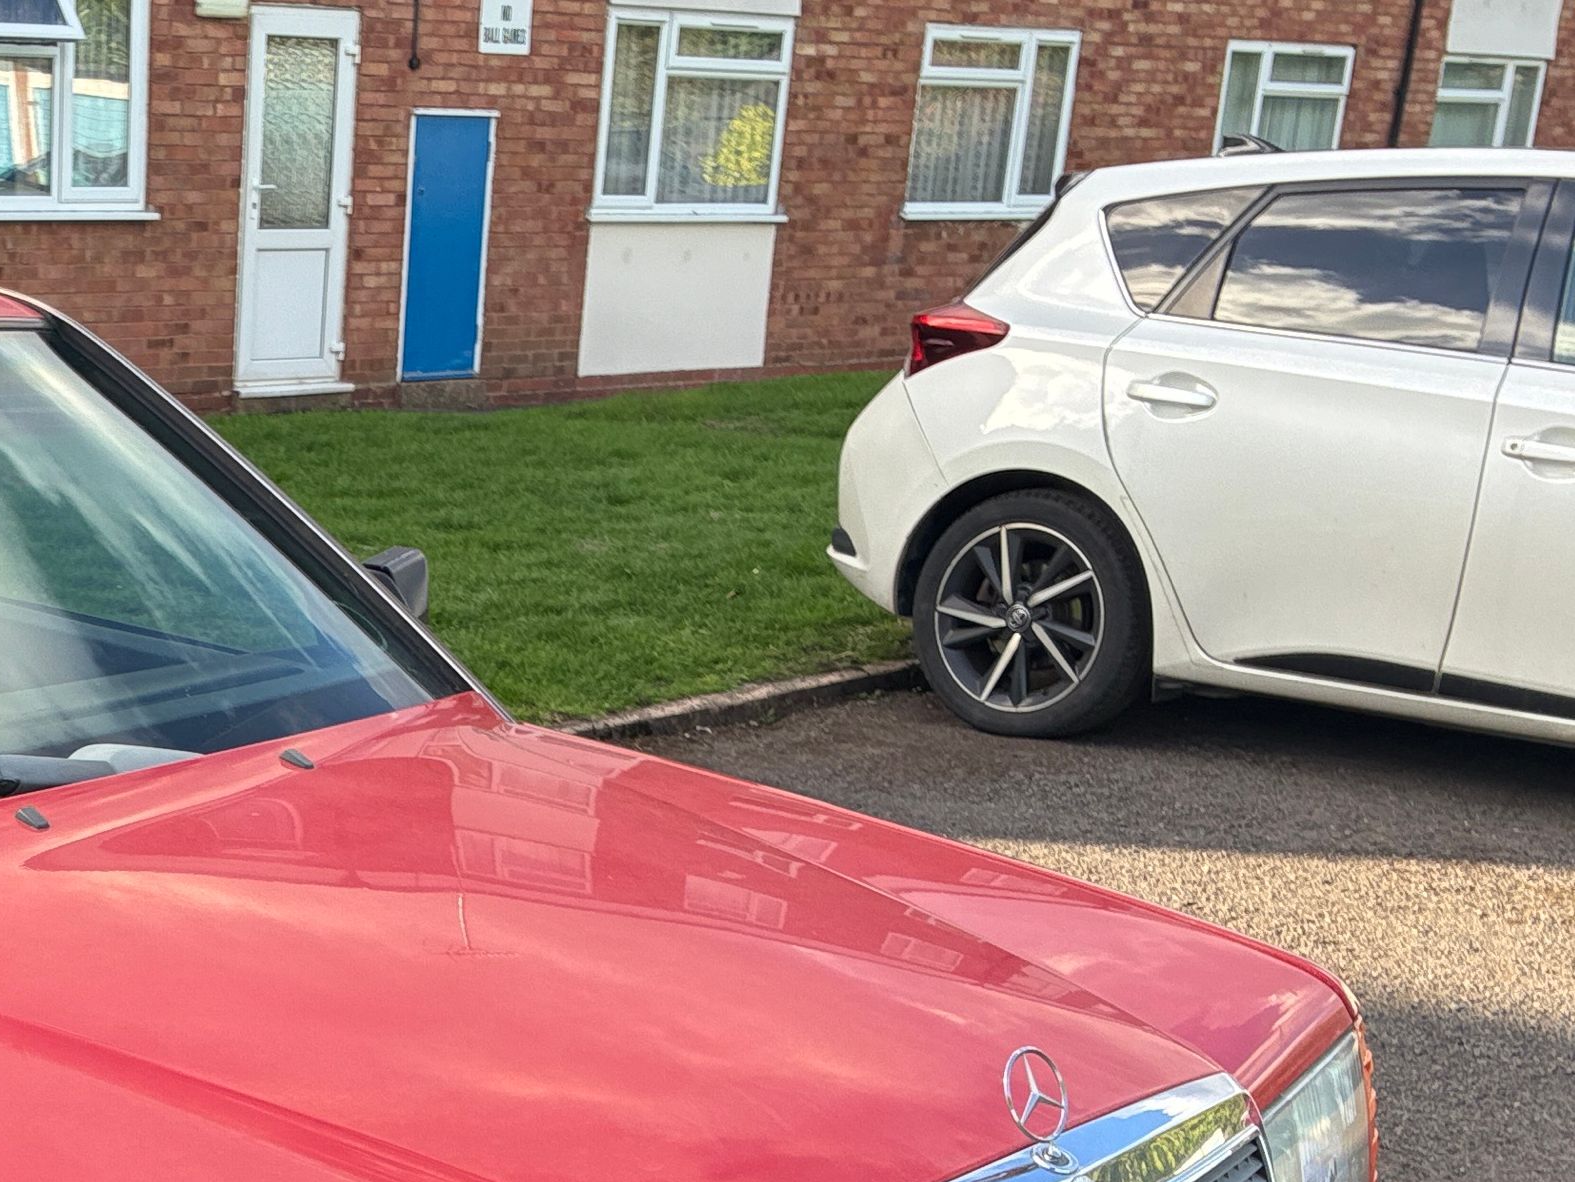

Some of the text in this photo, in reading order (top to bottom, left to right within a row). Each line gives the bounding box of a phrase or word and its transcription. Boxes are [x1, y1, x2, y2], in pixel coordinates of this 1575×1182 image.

[501, 4, 512, 21] NO
[483, 27, 527, 45] BALL GAMES
